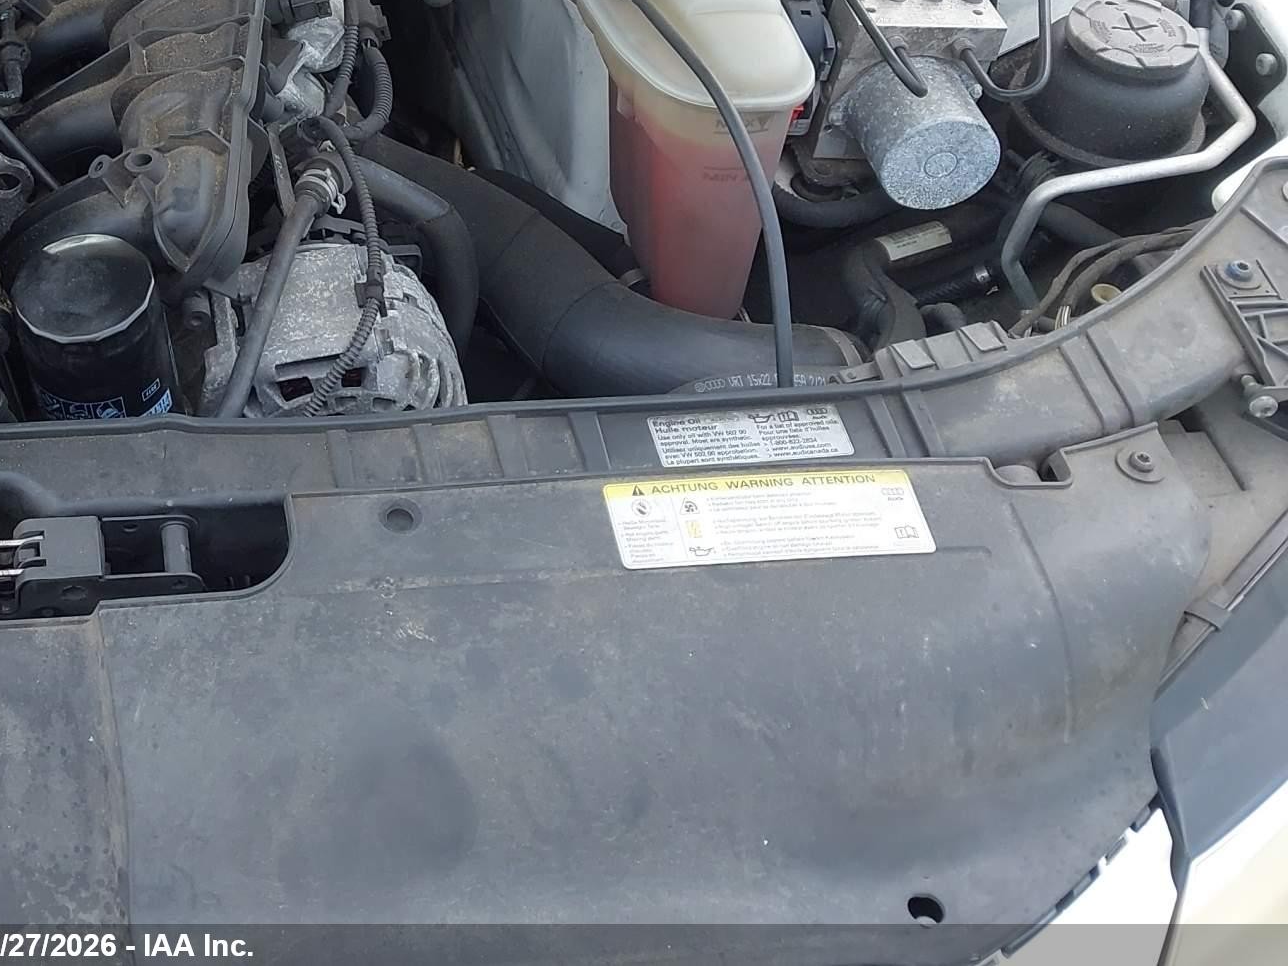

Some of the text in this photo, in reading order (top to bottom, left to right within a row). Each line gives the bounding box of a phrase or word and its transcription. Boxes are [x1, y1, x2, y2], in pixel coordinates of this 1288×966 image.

[653, 417, 701, 428] Engine Oil
[794, 419, 824, 428] approved
[672, 433, 686, 441] only
[651, 474, 876, 495] ACHTUNG WARNING ATTENTION
